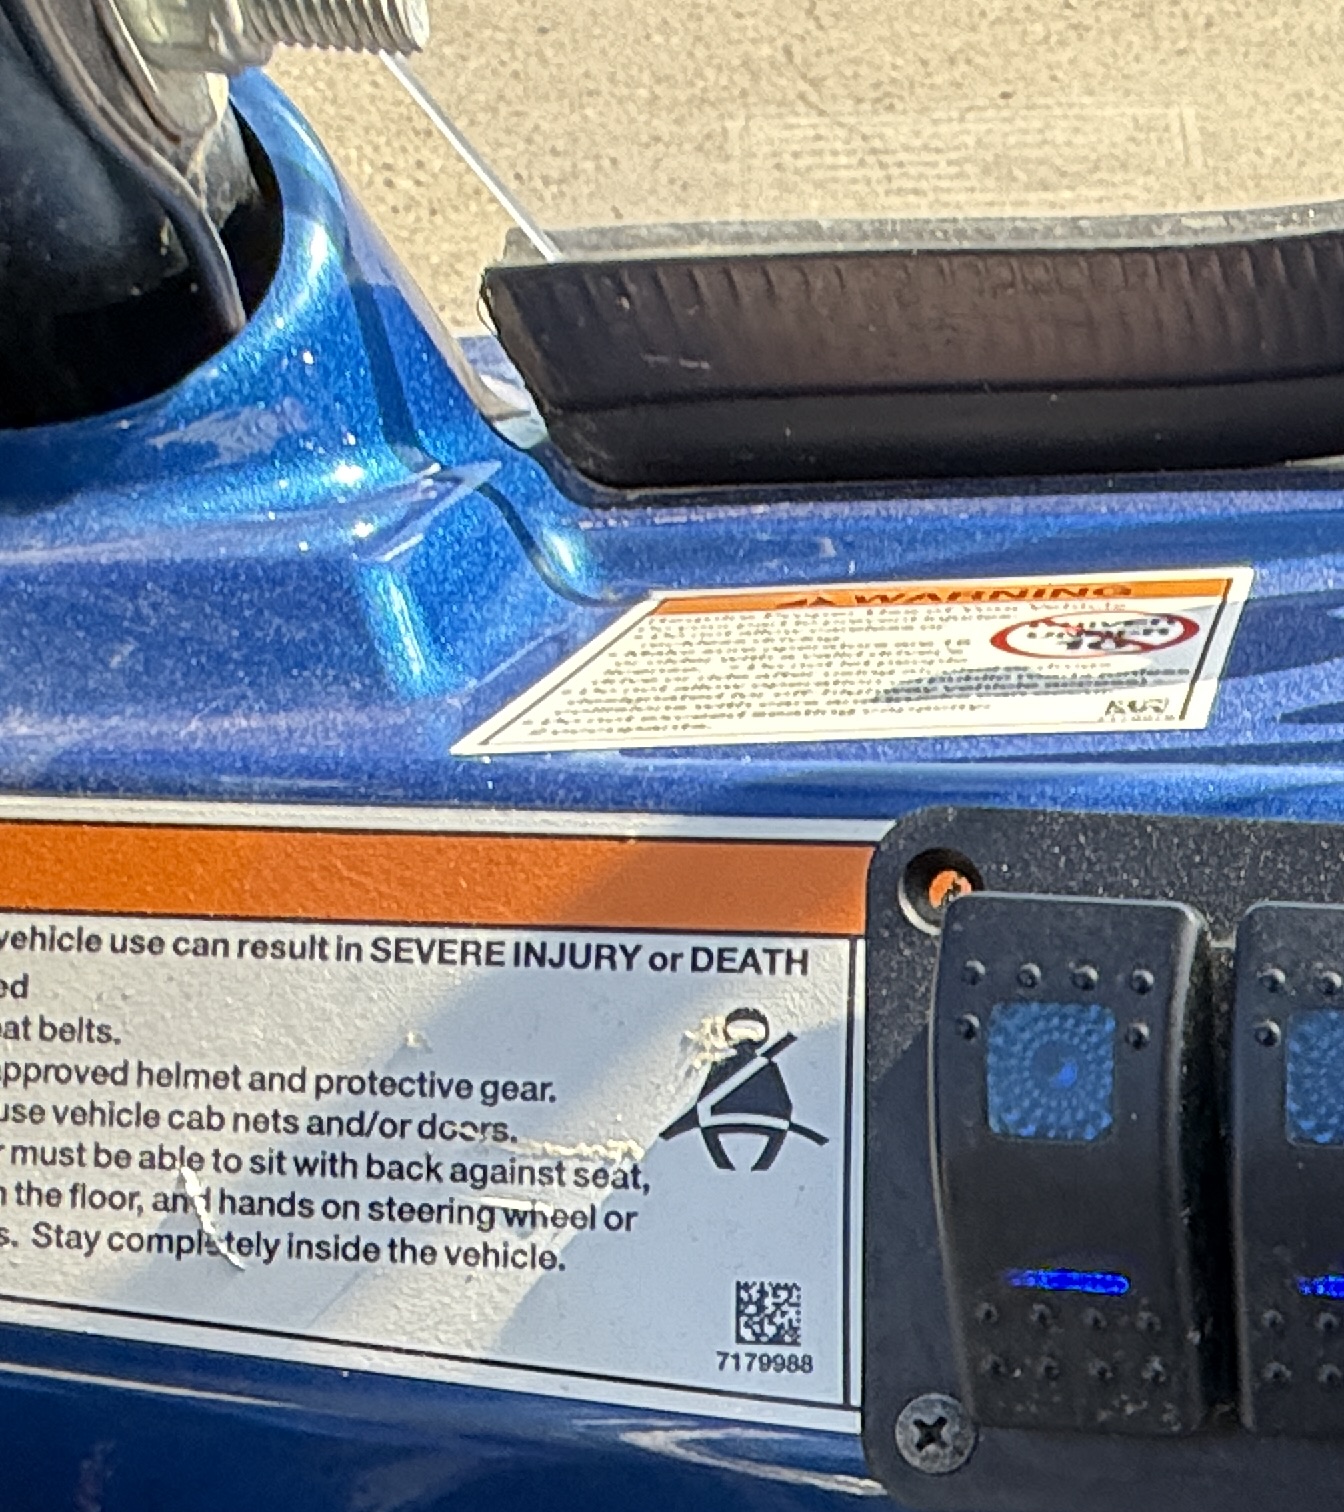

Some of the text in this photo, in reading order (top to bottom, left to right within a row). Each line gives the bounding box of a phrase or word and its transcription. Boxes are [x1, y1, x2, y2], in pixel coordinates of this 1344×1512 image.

[855, 585, 1131, 605] WARNING
[110, 932, 165, 955] use
[172, 935, 230, 958] can
[237, 936, 329, 962] result
[335, 936, 362, 963] in
[370, 938, 505, 966] SEVERE
[513, 941, 640, 970] INJURY
[649, 948, 683, 972] or
[691, 947, 809, 975] DEATH
[0, 1015, 121, 1045] at belts.
[0, 1059, 556, 1106] pproved helmet and protective gear.
[52, 1100, 160, 1128] vehicle
[168, 1105, 225, 1131] cab
[233, 1110, 299, 1134] nets
[306, 1112, 419, 1139] and/or
[11, 1142, 86, 1167] must
[94, 1141, 132, 1169] be
[138, 1145, 205, 1170] able
[212, 1148, 242, 1172] to
[249, 1148, 286, 1175] sit
[294, 1150, 357, 1180] with
[366, 1153, 444, 1182] back
[450, 1157, 566, 1191] against
[573, 1161, 650, 1195] seat,
[15, 1181, 62, 1206] the
[69, 1182, 144, 1214] floor,
[218, 1189, 314, 1217] hands
[322, 1196, 360, 1220] on
[368, 1197, 495, 1232] steering
[503, 1204, 596, 1231] wheel
[604, 1209, 638, 1231] or
[32, 1221, 100, 1257] Stay
[287, 1232, 381, 1263] inside
[388, 1239, 436, 1265] the
[444, 1243, 566, 1272] vehicle.
[716, 1350, 814, 1373] 7179988
